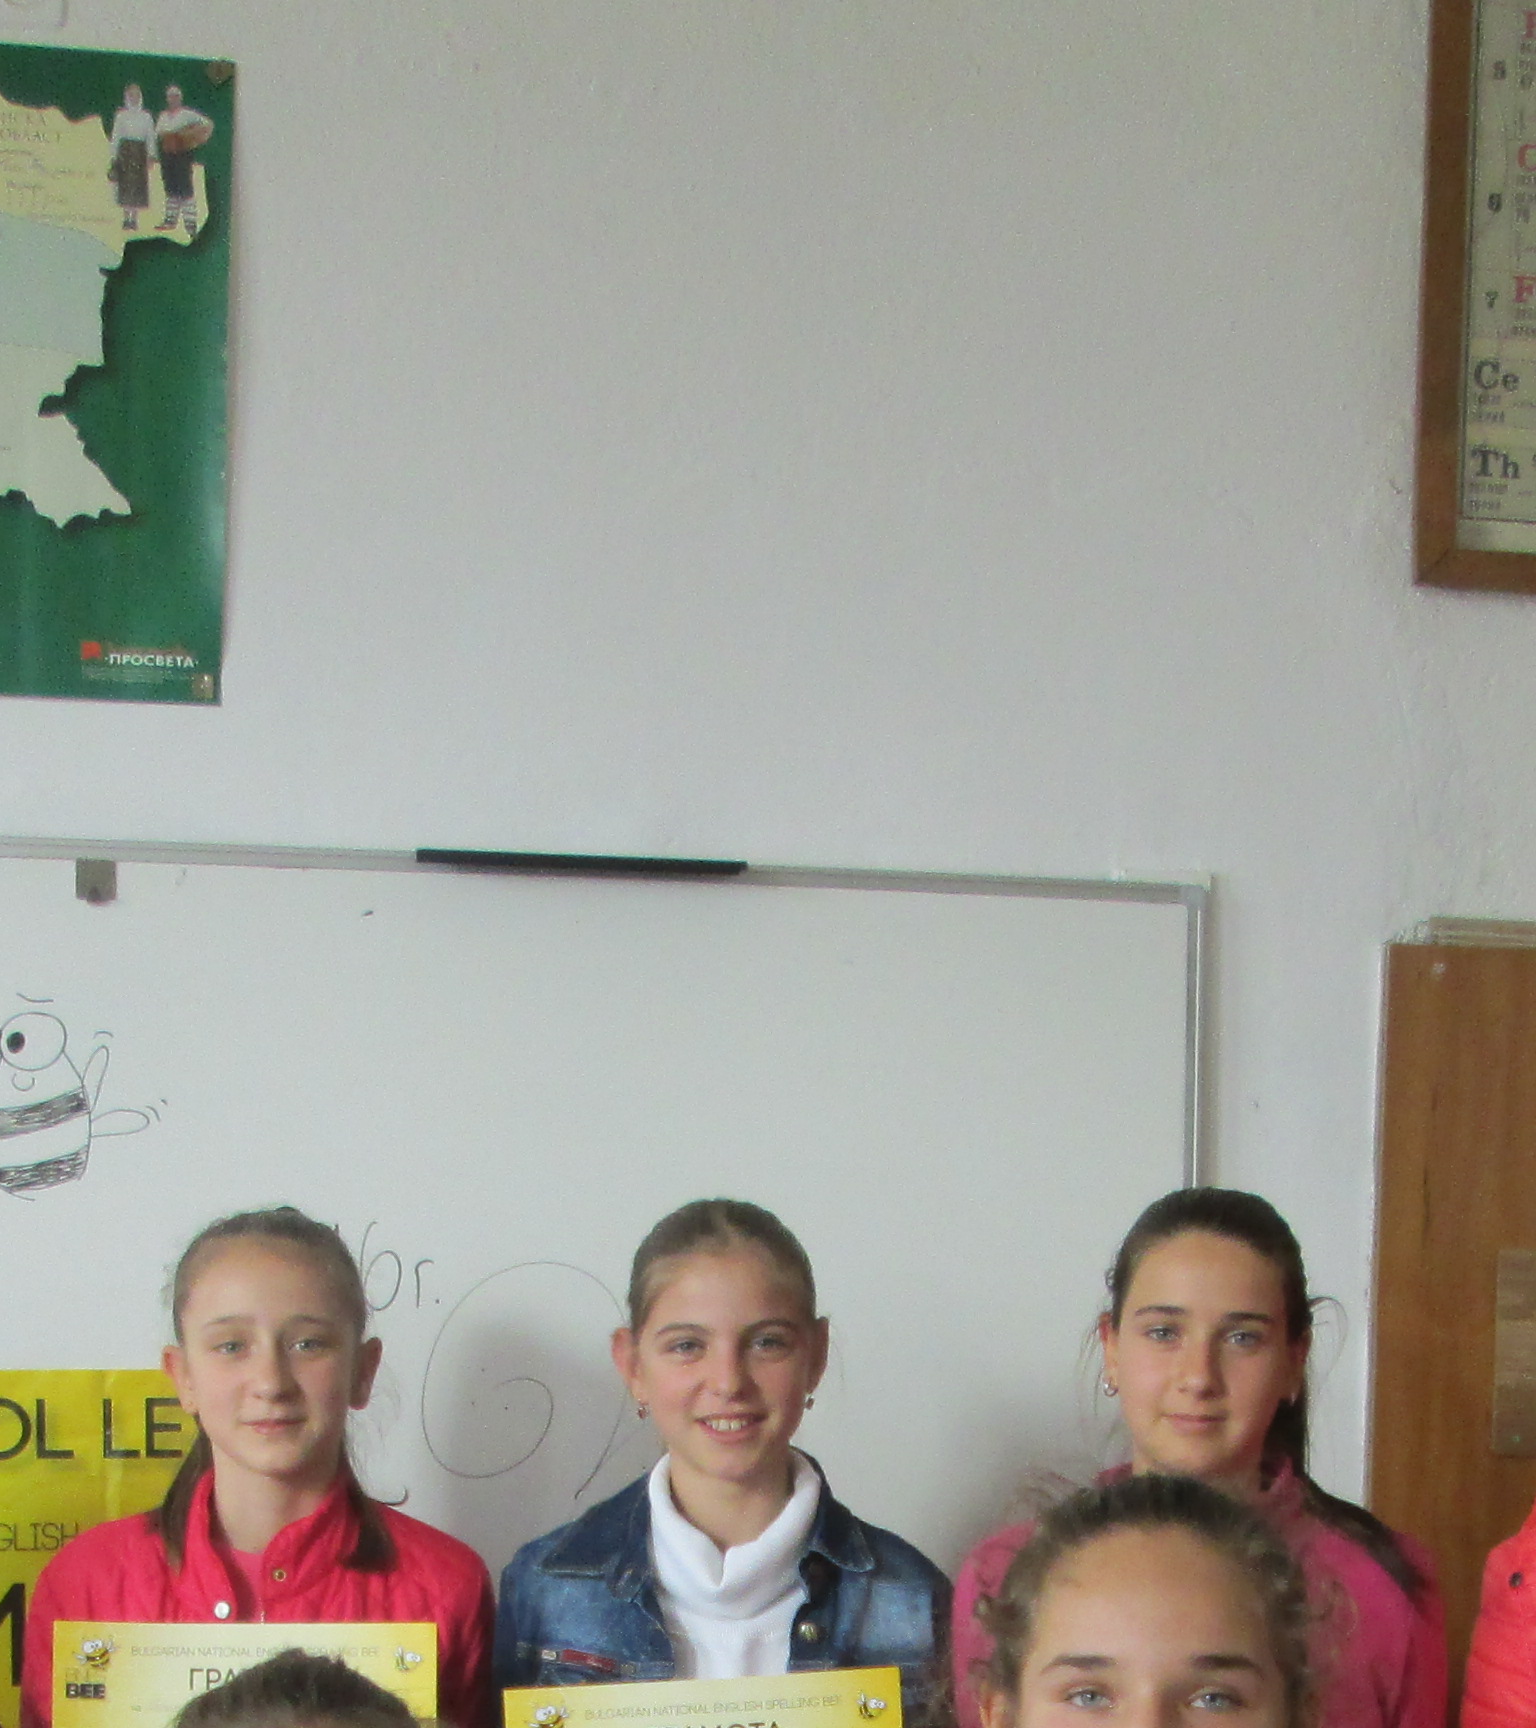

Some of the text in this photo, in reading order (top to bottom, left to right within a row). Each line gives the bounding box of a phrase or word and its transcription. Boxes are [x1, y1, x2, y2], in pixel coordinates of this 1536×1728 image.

[1474, 358, 1520, 392] Ce
[1473, 446, 1520, 480] Th
[66, 1683, 106, 1698] BEE
[584, 1706, 651, 1722] BULGARIAN
